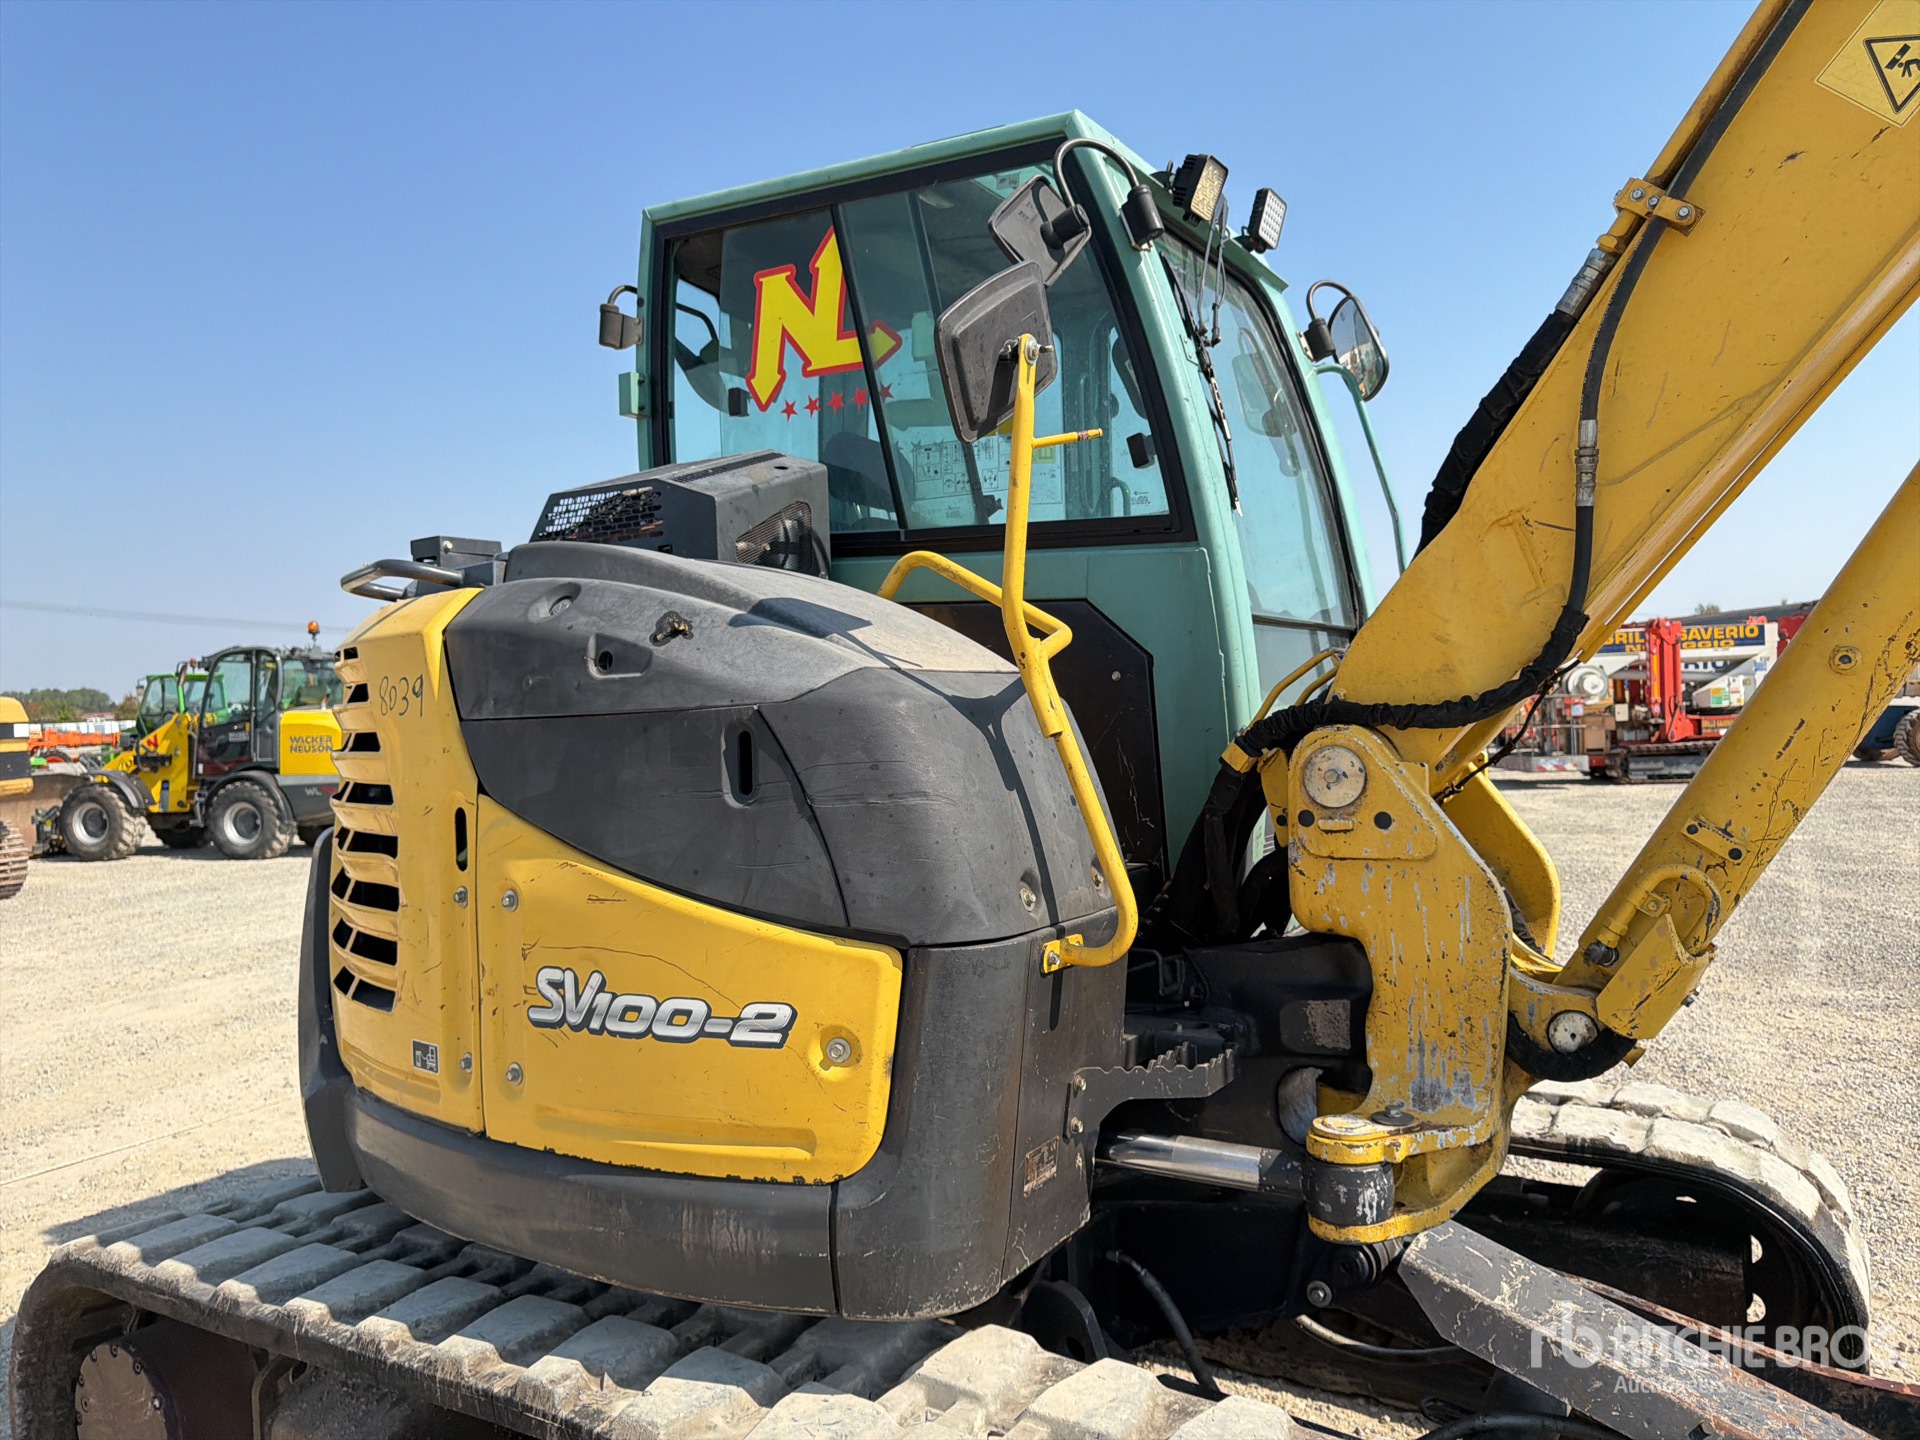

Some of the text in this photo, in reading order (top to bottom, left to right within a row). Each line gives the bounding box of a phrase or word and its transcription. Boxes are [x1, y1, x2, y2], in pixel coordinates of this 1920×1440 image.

[379, 673, 424, 718] 8039
[289, 735, 333, 745] WACKER
[289, 744, 334, 754] NEUSON
[528, 966, 798, 1049] SV100-2
